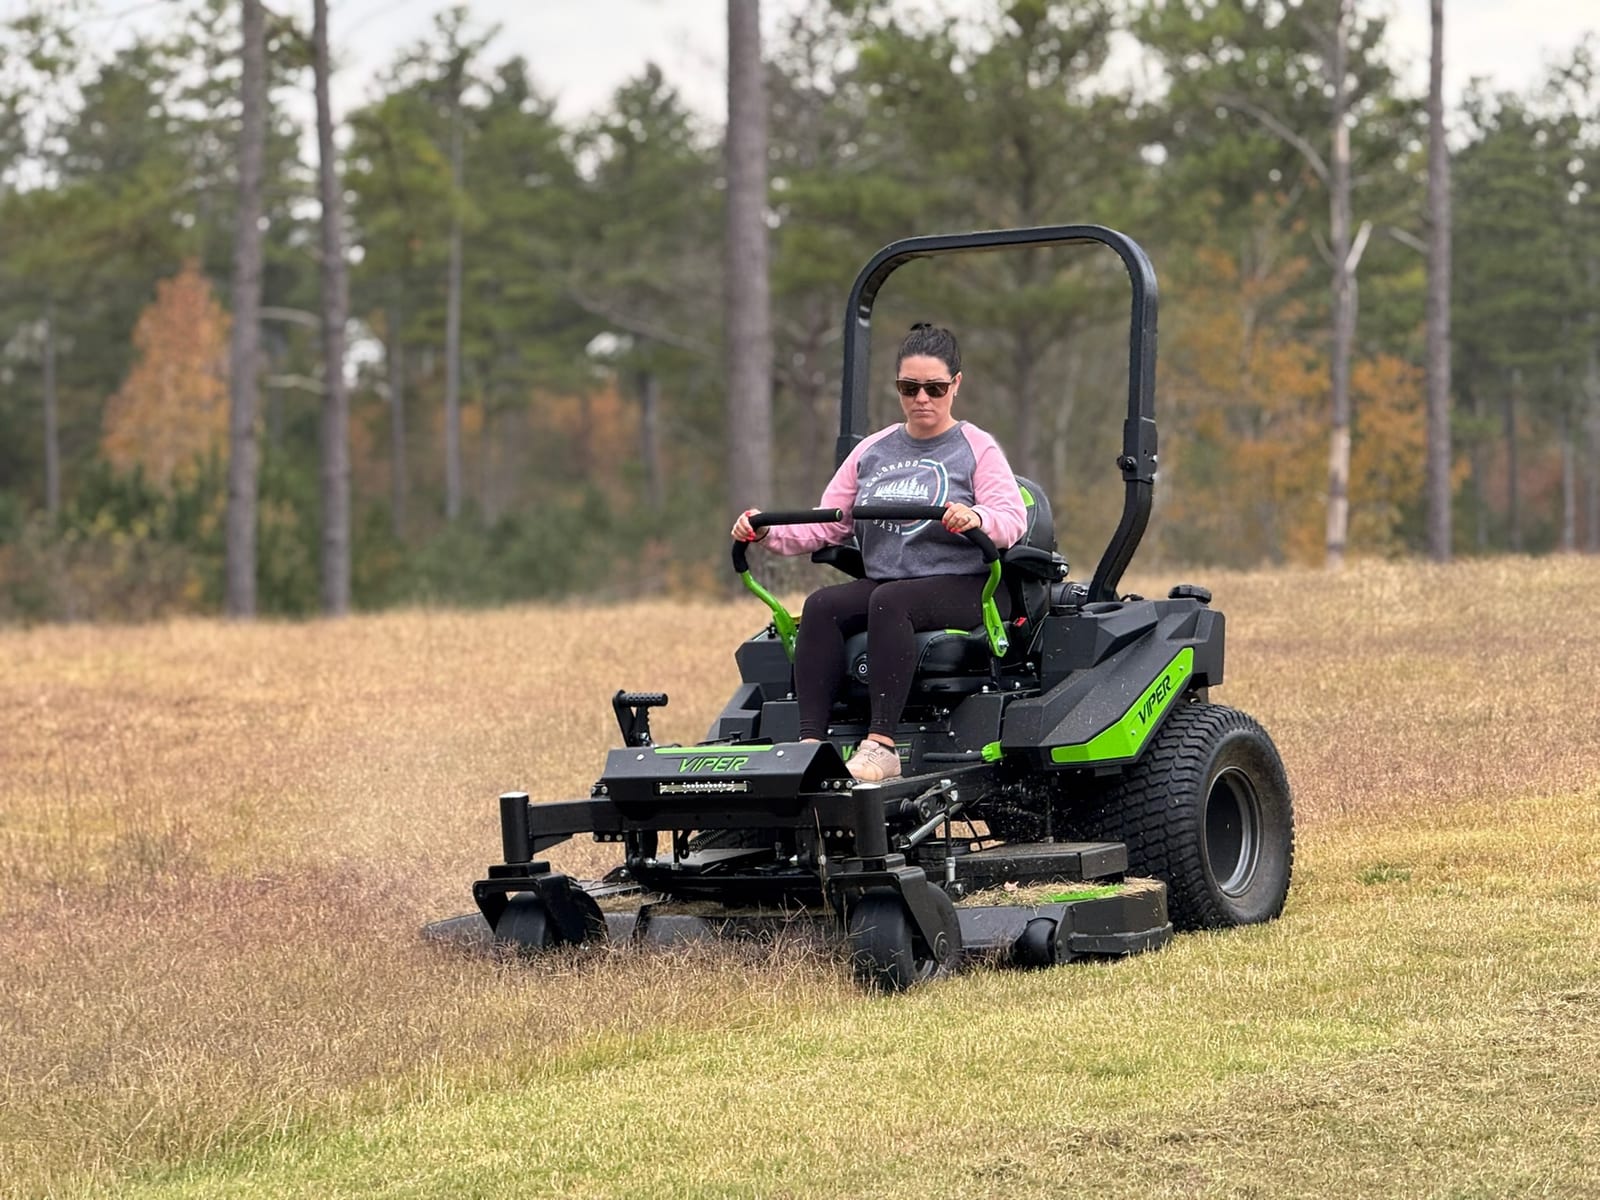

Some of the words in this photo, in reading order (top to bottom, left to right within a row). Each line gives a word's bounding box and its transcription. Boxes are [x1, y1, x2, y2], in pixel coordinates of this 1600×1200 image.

[865, 460, 919, 488] COLORADO
[1138, 675, 1171, 724] VIPER
[679, 757, 749, 773] VIPER
